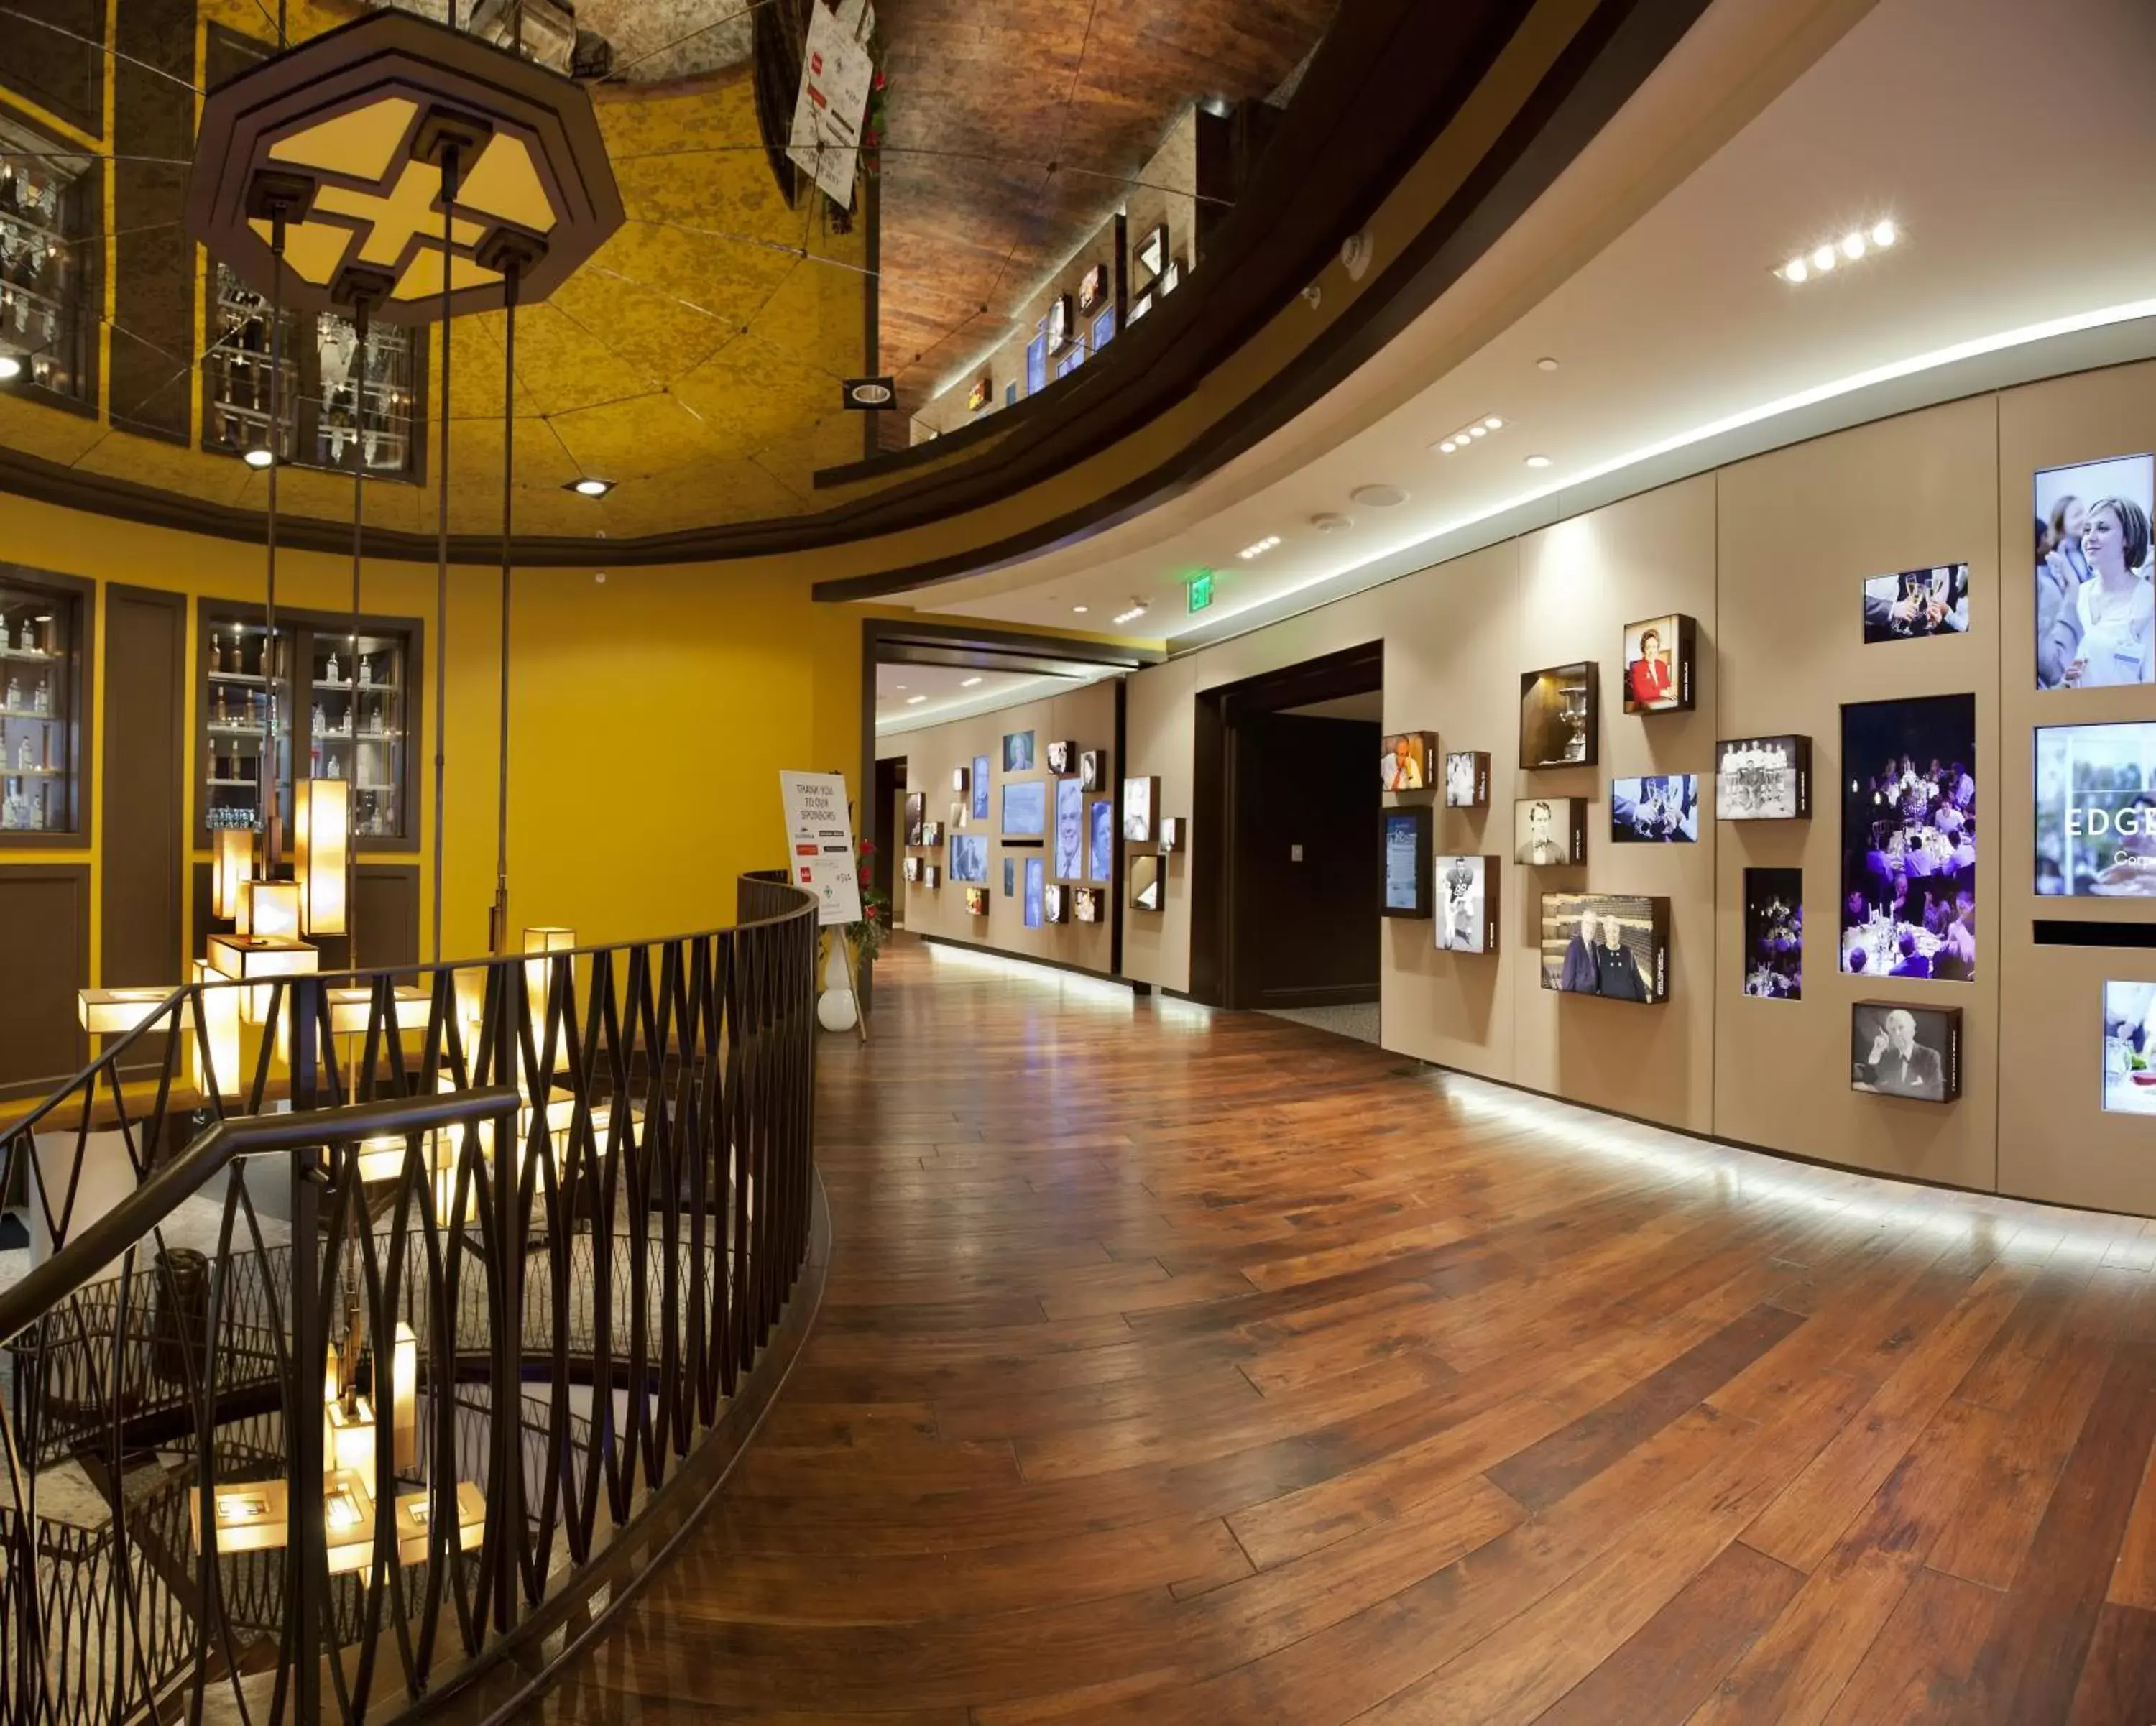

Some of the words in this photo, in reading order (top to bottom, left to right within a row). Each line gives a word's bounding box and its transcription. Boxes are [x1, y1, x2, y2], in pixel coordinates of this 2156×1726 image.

[796, 784, 819, 795] THANK
[820, 785, 833, 795] YOU
[805, 797, 814, 807] TO
[815, 798, 828, 808] OUR
[801, 810, 836, 821] SPONSORS
